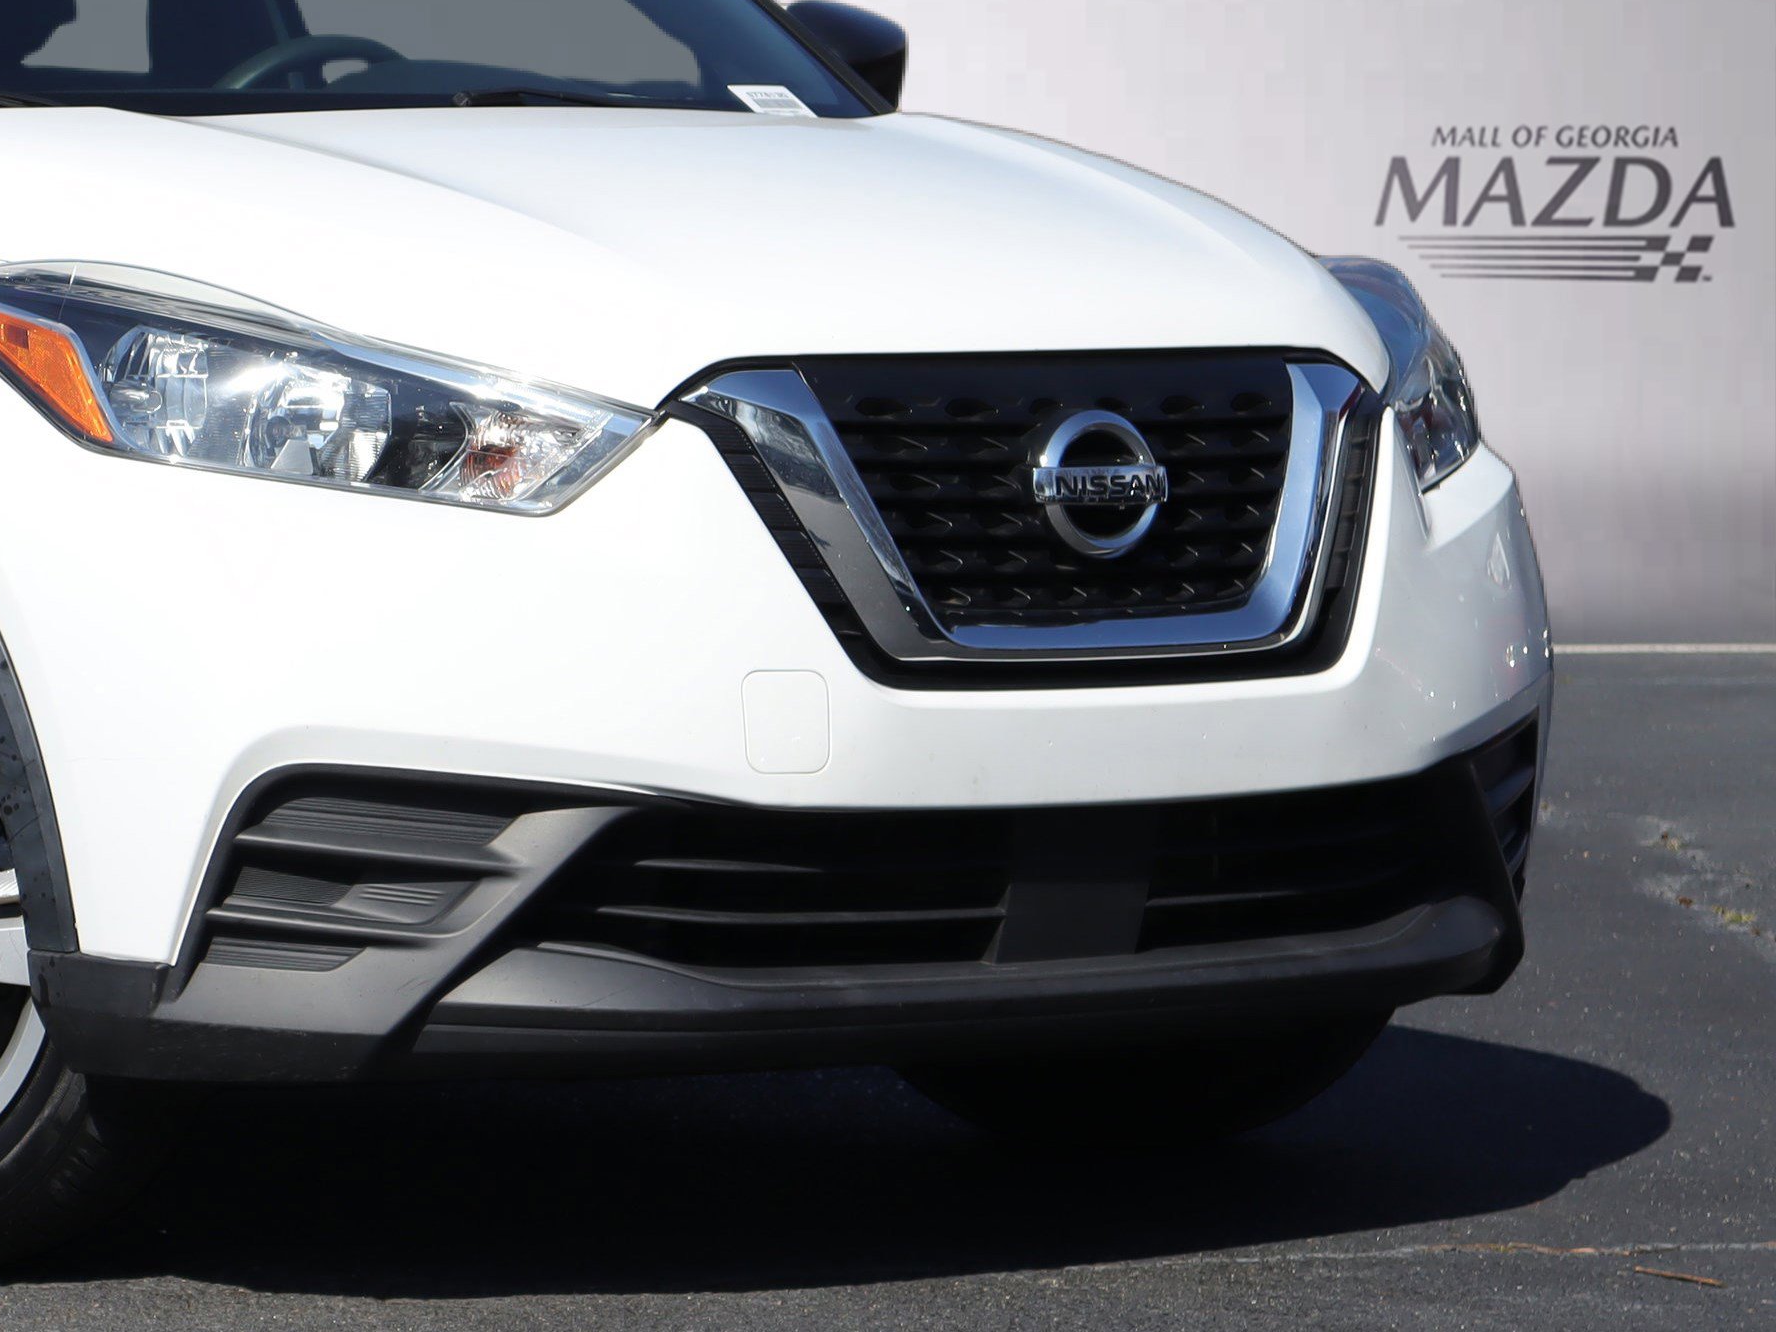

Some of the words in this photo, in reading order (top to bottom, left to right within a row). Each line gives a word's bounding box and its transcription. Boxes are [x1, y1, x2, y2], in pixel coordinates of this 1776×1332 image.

[1432, 126, 1501, 147] MALL
[1511, 125, 1548, 148] OF
[1555, 125, 1678, 148] GEORGIA
[1375, 156, 1735, 228] MAZDA
[1055, 474, 1161, 496] NISSAN
